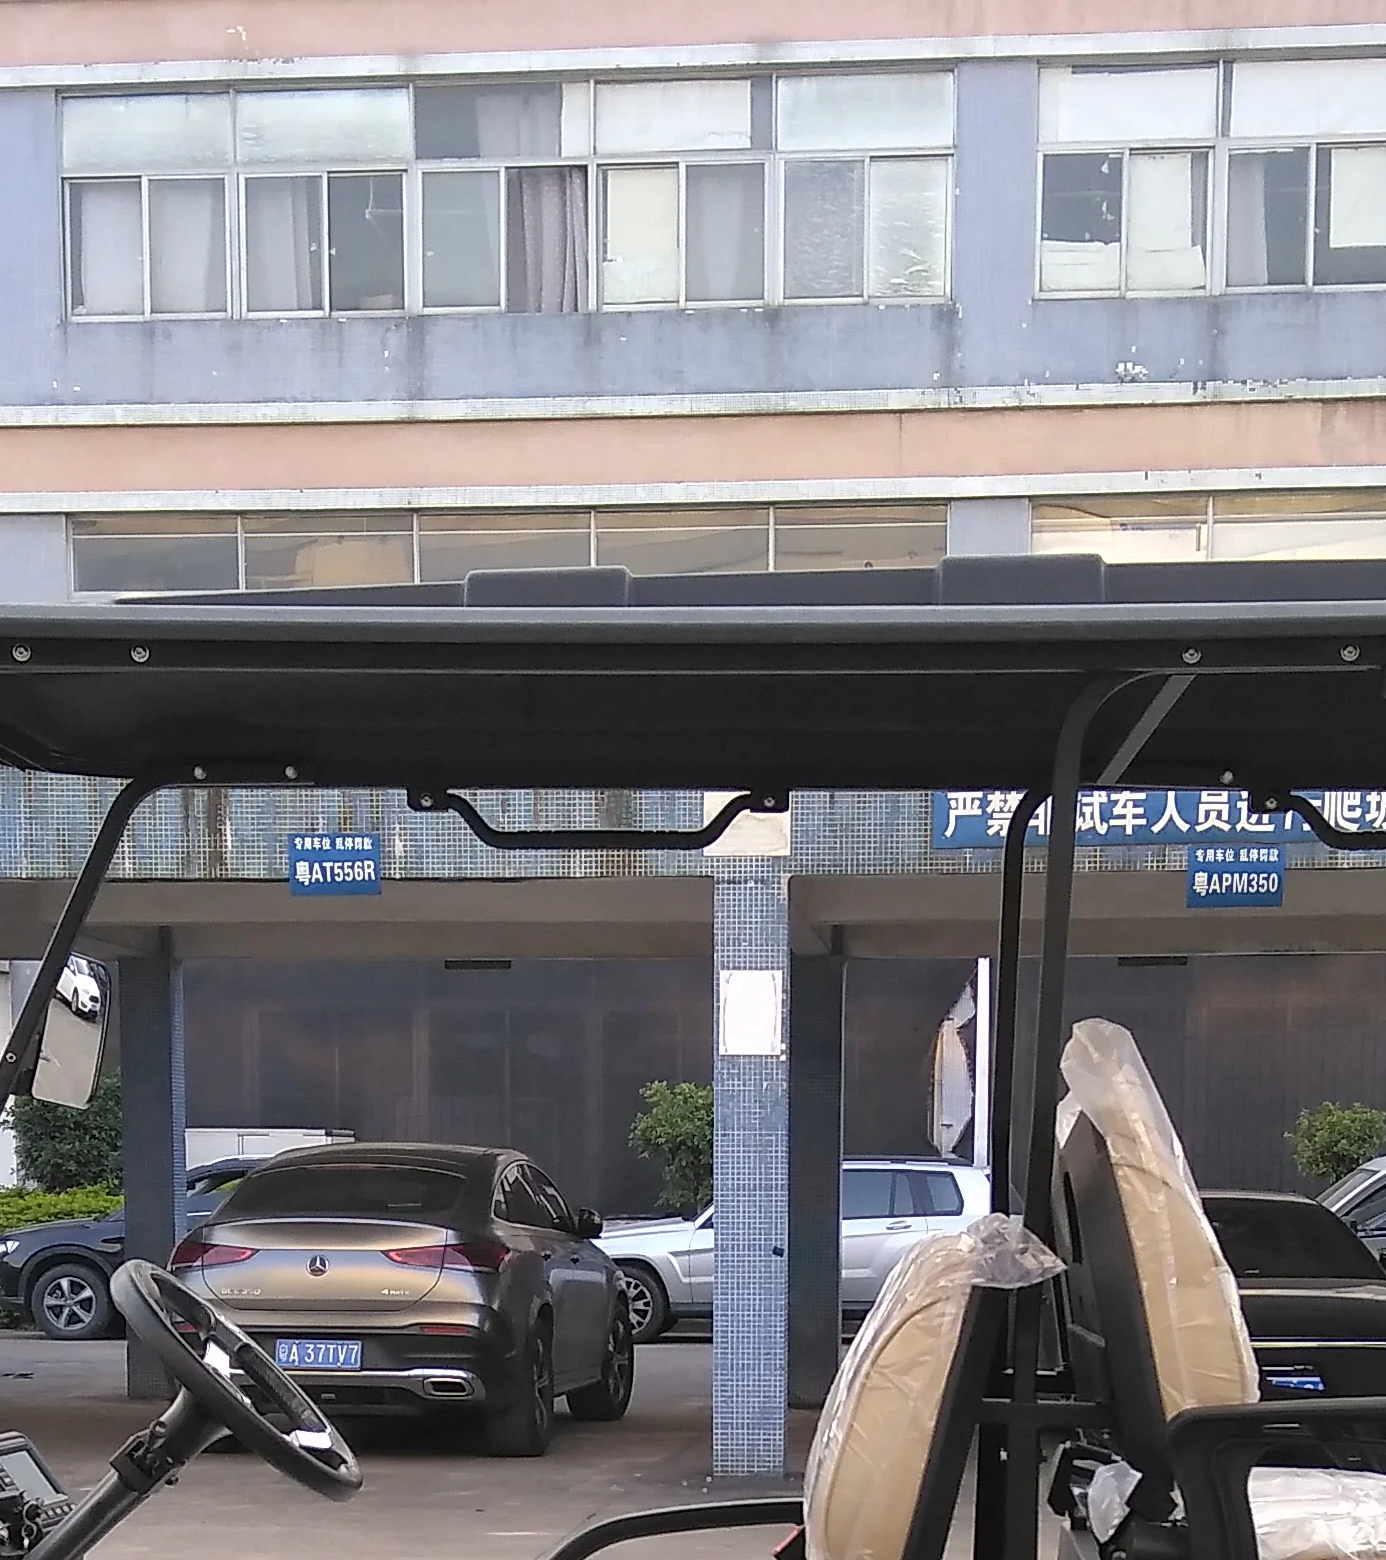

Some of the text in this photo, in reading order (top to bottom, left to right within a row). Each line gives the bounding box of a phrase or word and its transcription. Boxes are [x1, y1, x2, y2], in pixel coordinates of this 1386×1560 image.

[1195, 848, 1235, 862] 专用车位
[294, 861, 376, 886] 粤AT556R
[1193, 871, 1279, 897] 粤APM350
